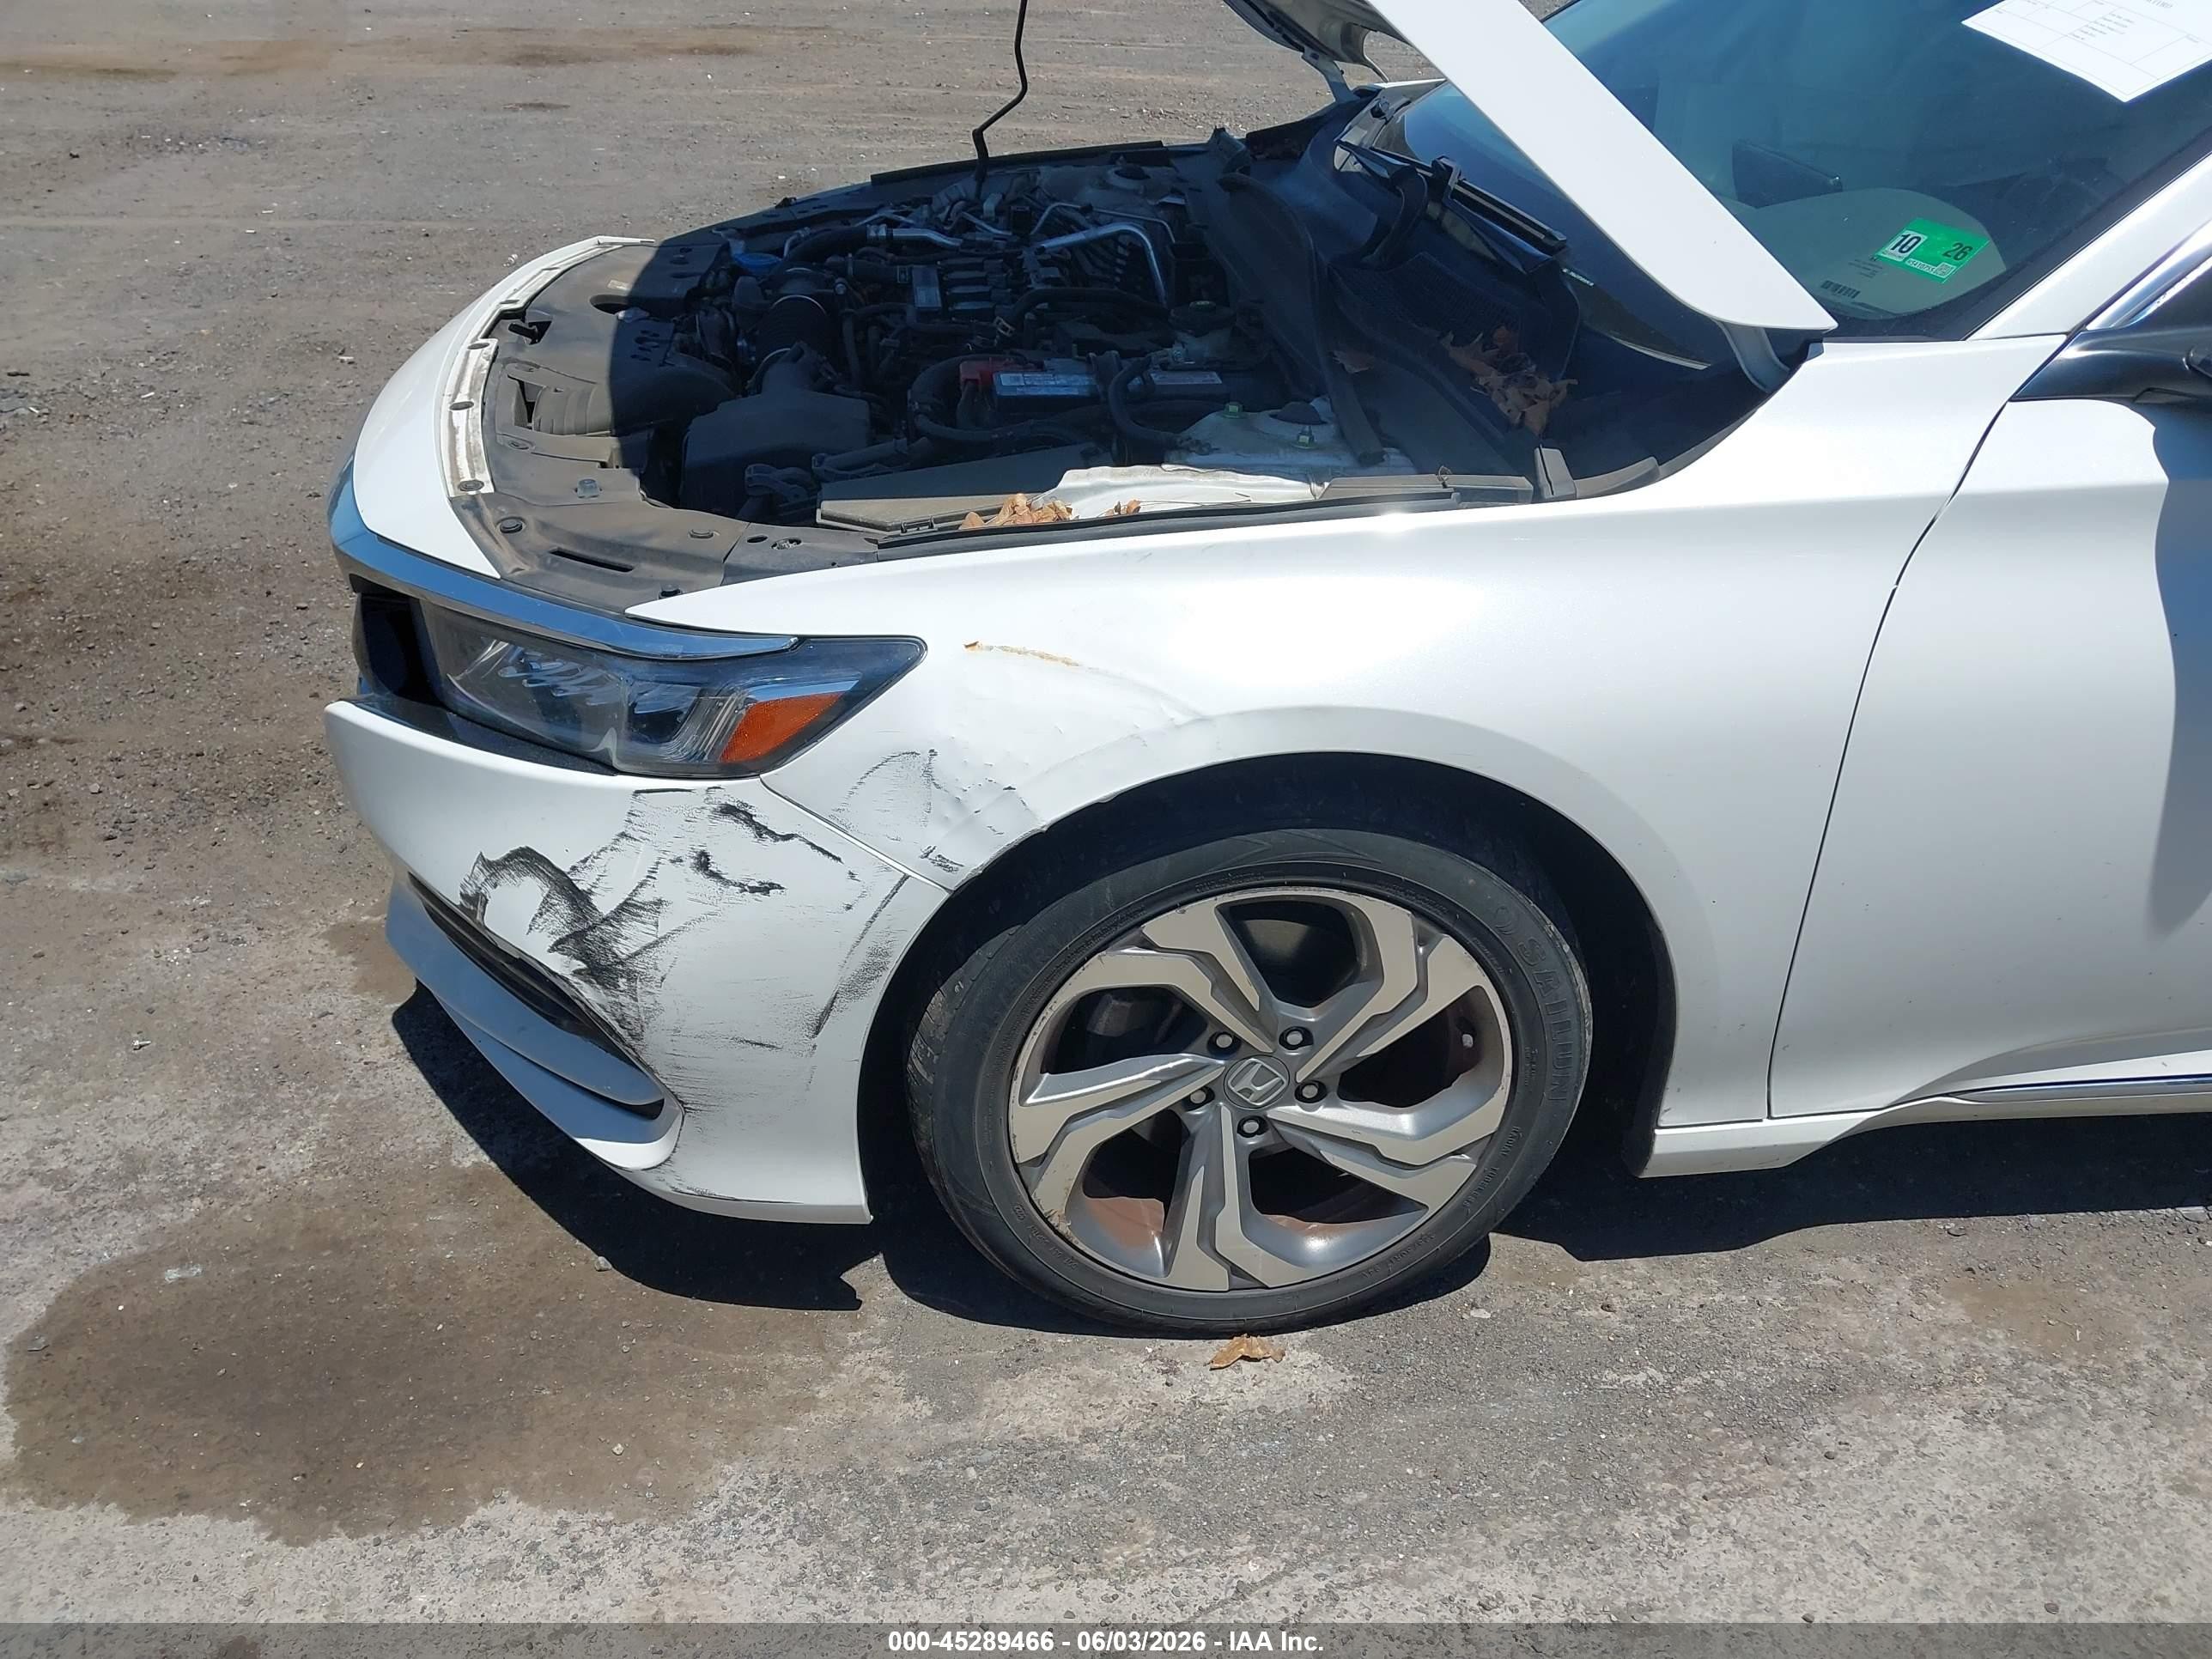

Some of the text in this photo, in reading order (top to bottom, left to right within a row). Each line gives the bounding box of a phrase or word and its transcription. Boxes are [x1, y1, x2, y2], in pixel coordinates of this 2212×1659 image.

[1890, 234, 1922, 253] 10
[1942, 242, 1973, 261] 26
[1518, 936, 1573, 1101] SAILUN
